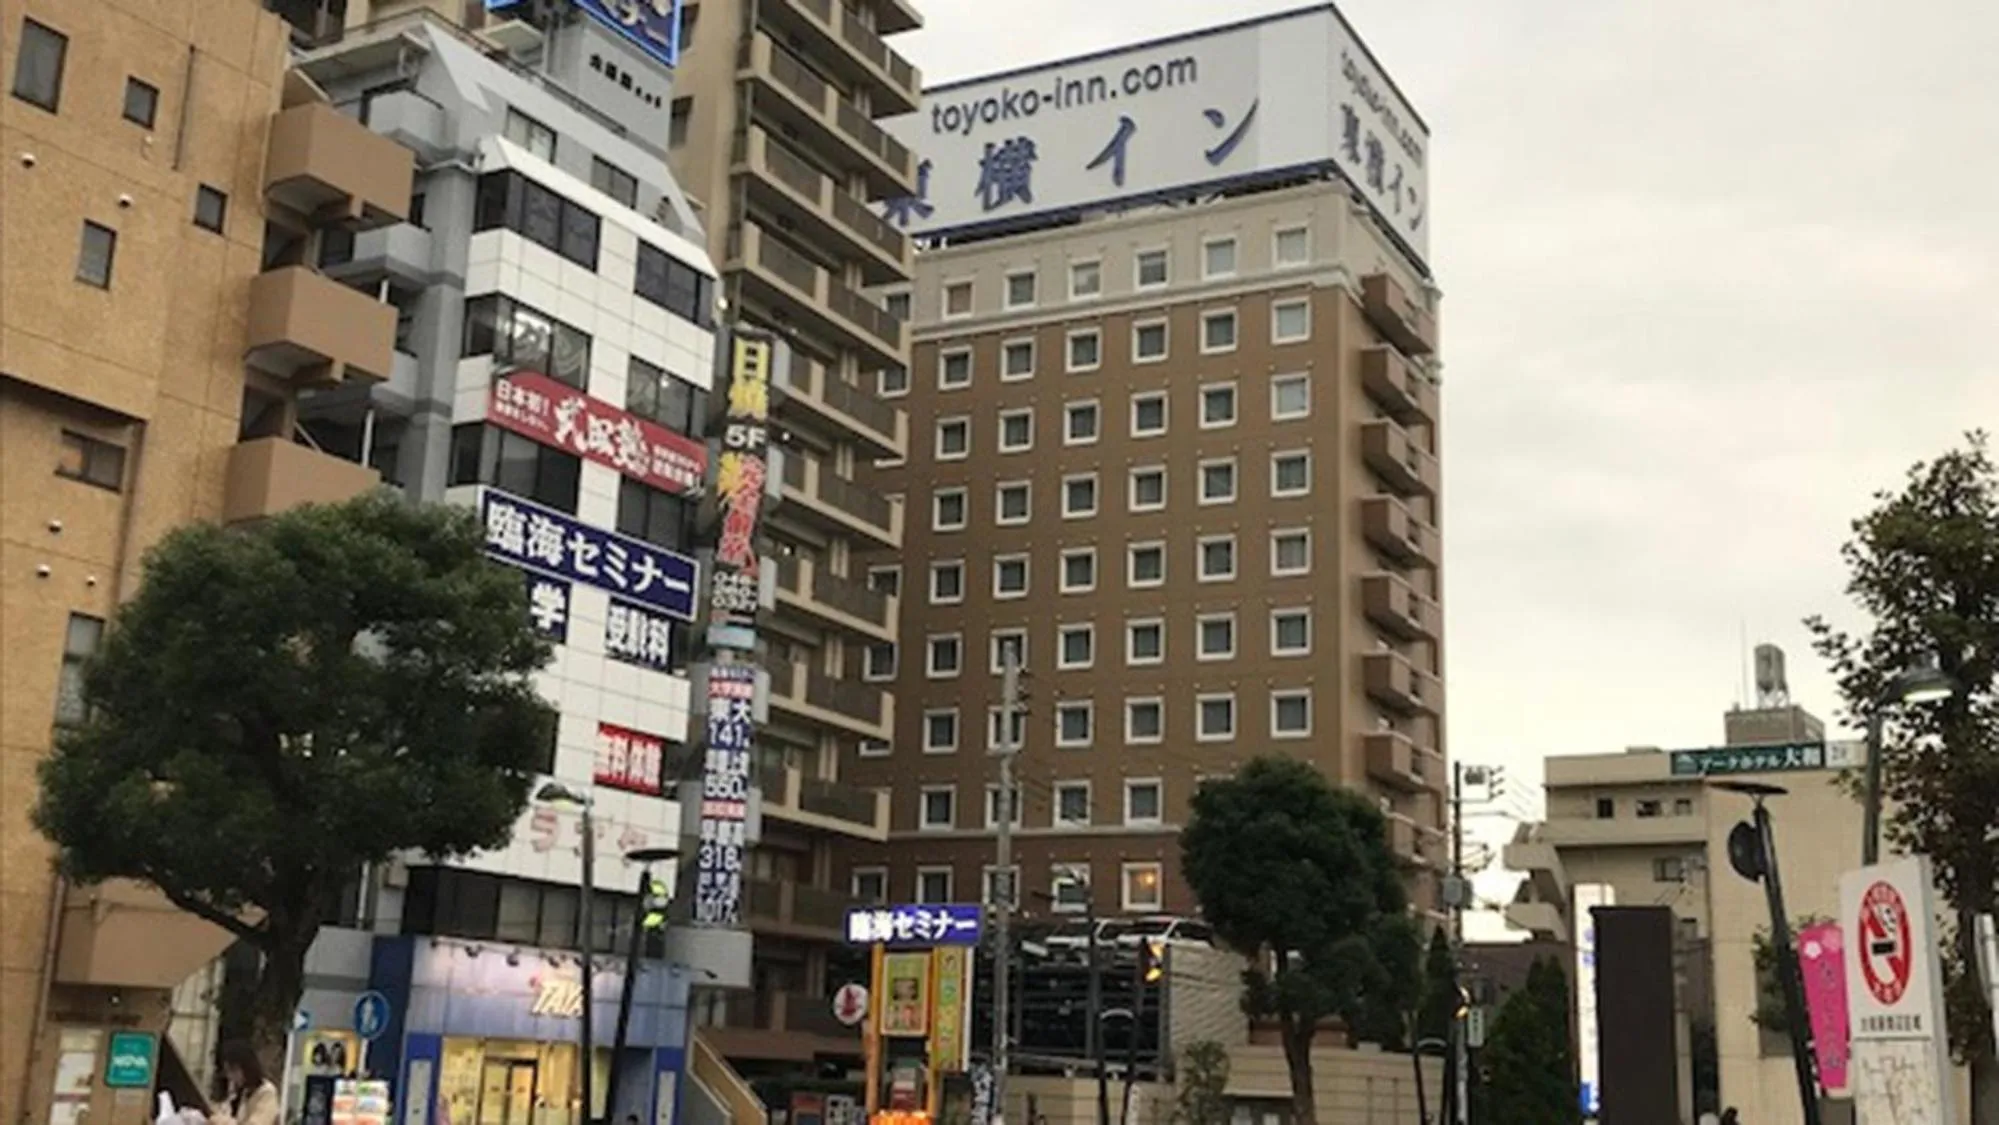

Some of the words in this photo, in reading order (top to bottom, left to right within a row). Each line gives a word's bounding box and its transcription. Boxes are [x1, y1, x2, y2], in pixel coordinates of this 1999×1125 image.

[932, 55, 1198, 136] toyoko-inn.com
[725, 424, 766, 448] 5F
[486, 501, 690, 593] 臨海セミナー
